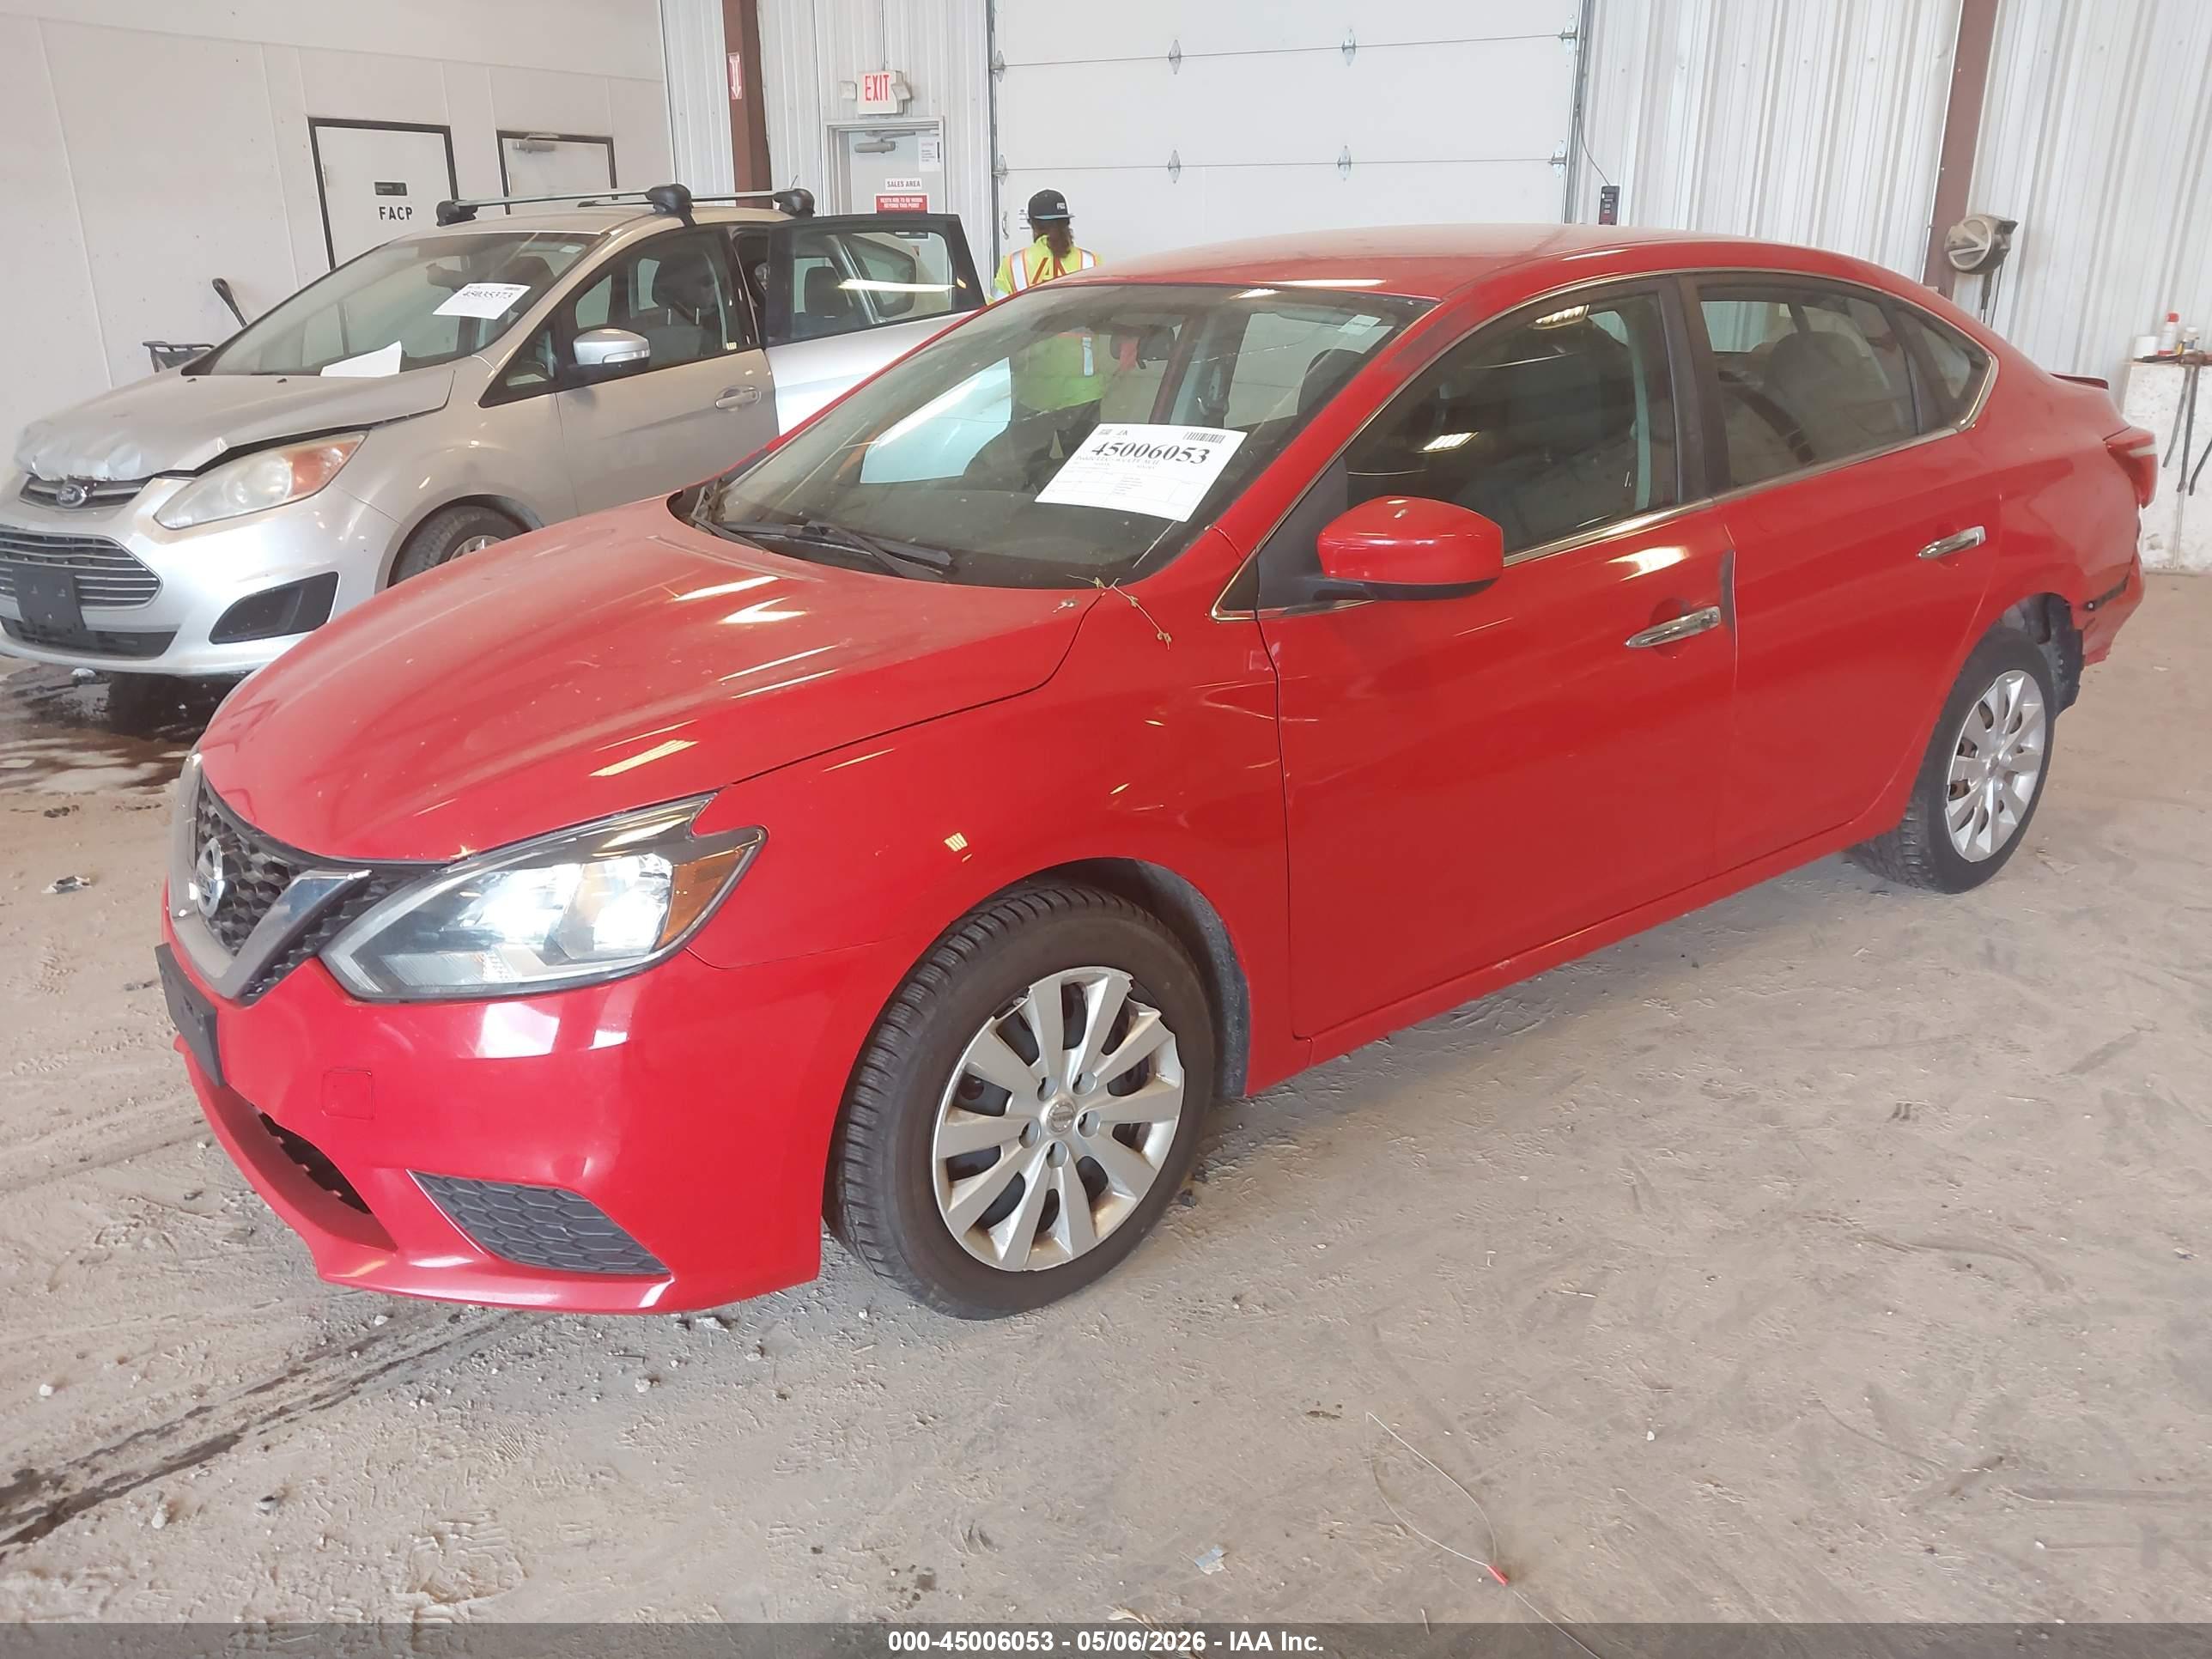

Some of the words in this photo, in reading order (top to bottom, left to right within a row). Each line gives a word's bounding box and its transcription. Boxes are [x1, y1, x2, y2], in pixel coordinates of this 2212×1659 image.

[865, 75, 890, 101] EXIT
[379, 206, 413, 221] FACP
[1091, 441, 1211, 465] 45006053
